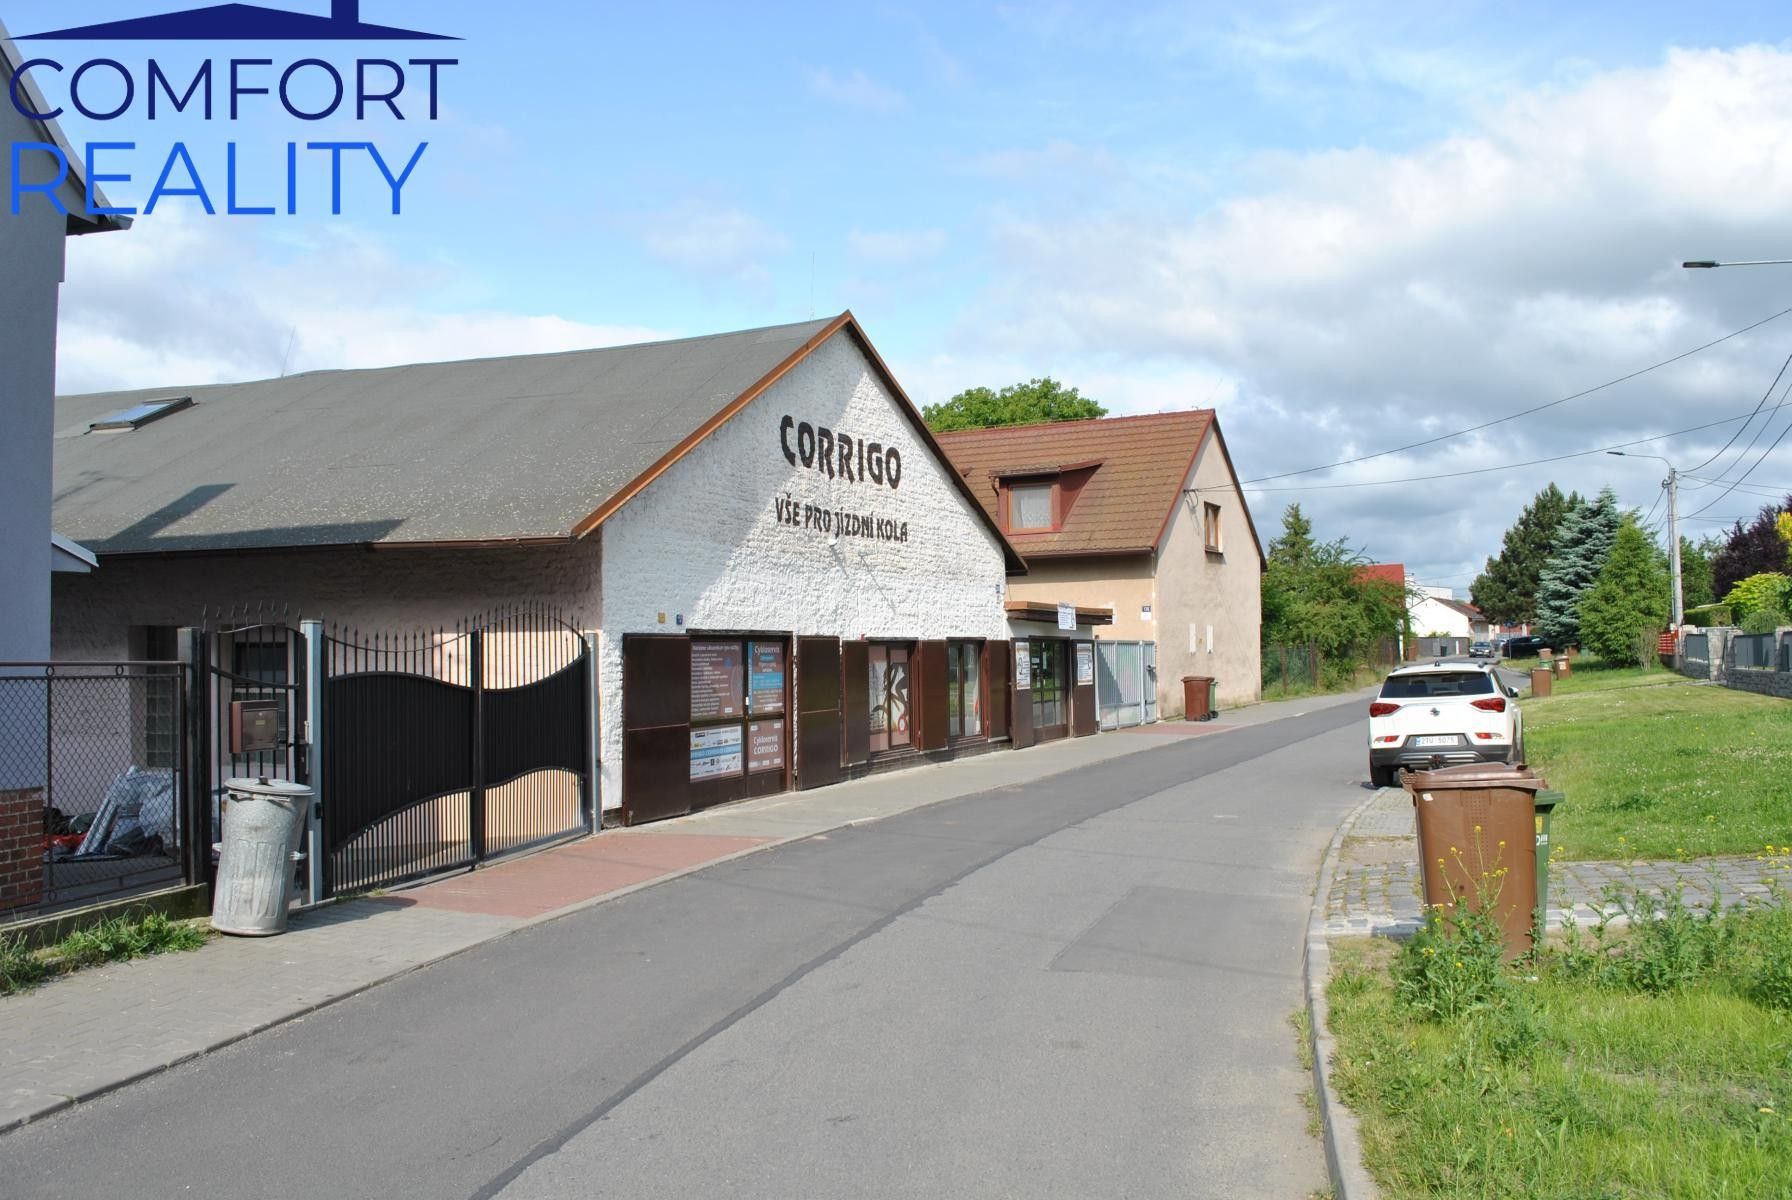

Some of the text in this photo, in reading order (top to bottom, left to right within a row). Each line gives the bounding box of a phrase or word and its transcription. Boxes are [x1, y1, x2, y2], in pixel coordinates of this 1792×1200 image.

[780, 414, 901, 489] CORRIGO
[775, 492, 908, 544] VŠE PRO JÍZDNÍ KOLA
